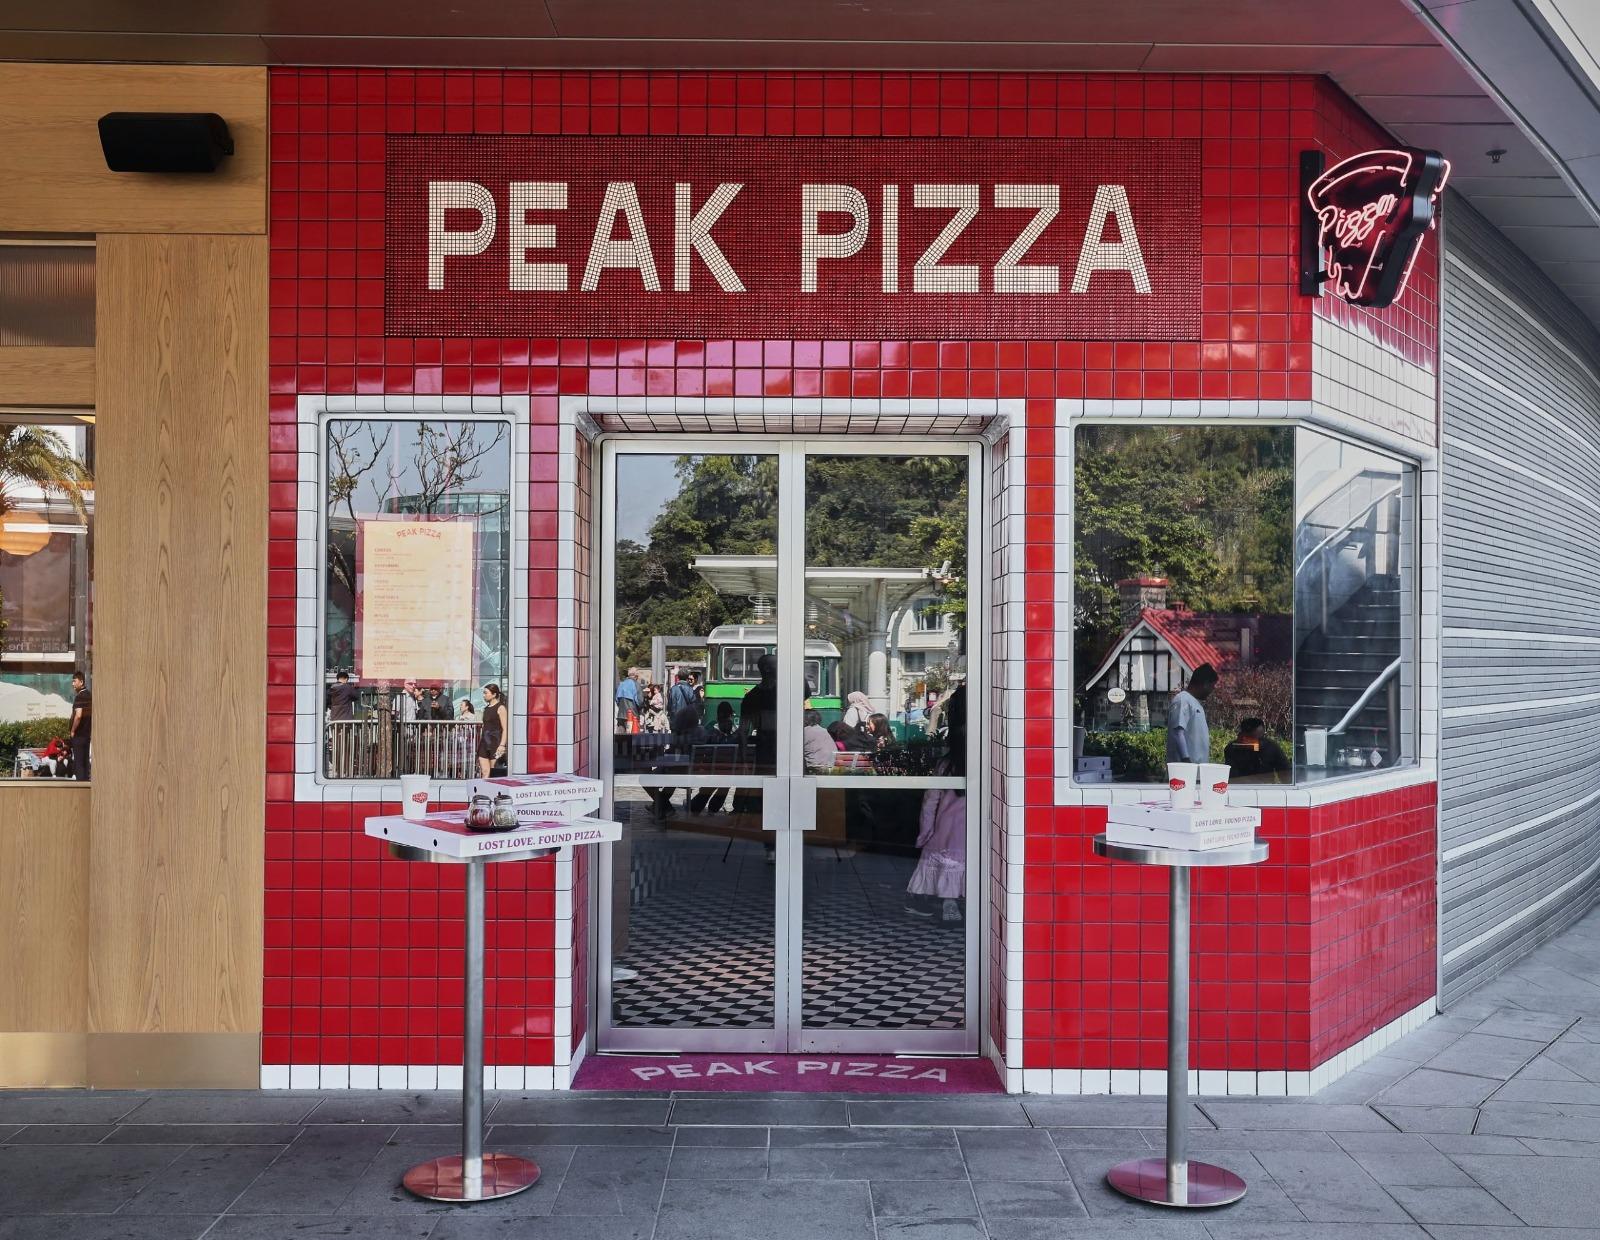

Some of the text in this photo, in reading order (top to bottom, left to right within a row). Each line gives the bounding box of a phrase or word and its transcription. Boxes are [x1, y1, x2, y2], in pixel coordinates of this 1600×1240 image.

[427, 180, 1153, 295] PEAK PIZZA
[396, 527, 442, 540] PEAK PIZZA
[554, 788, 577, 796] FOUND
[542, 809, 565, 817] PIZZA.
[478, 829, 605, 851] LOST LOVE. FOUND PIZZA.
[629, 1060, 948, 1083] PEAK PIZZA
